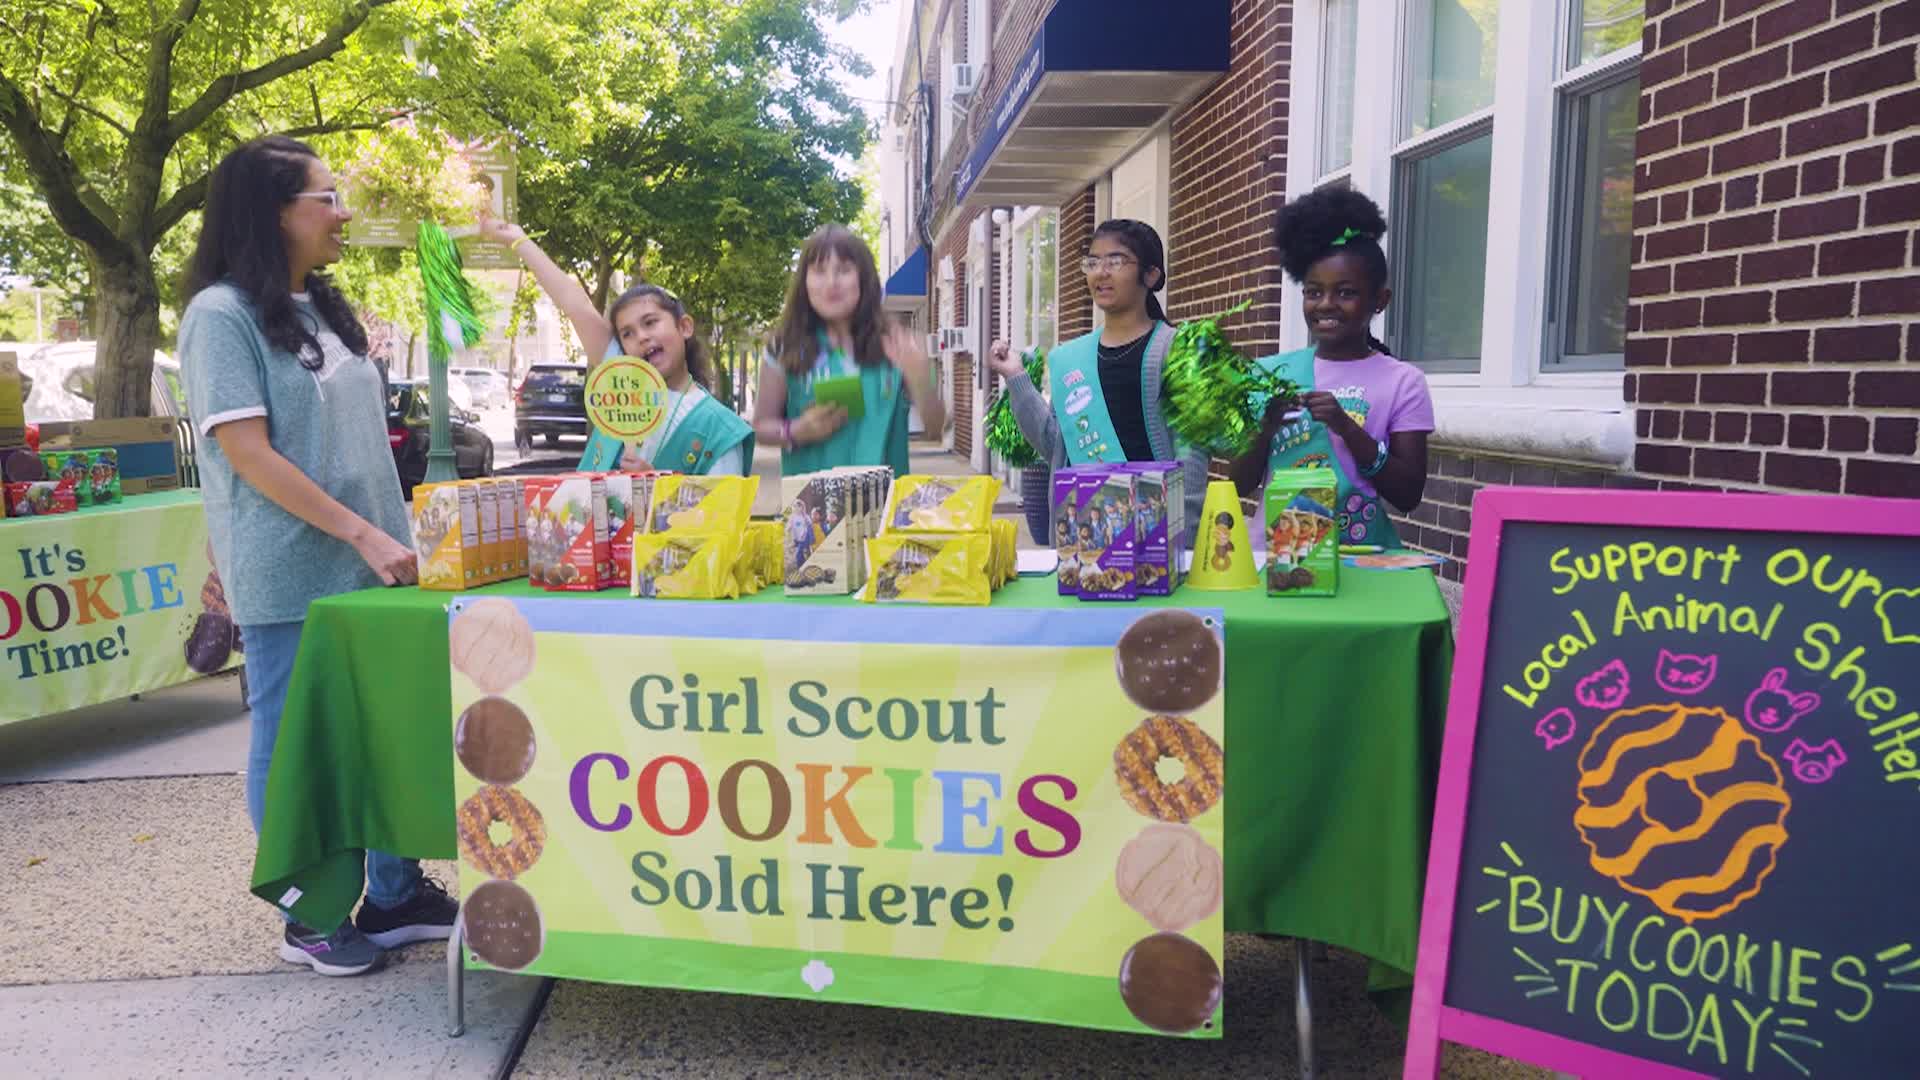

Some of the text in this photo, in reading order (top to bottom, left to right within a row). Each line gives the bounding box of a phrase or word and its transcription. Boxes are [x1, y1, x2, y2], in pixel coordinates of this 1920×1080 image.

[589, 391, 664, 408] COOKIE
[605, 408, 651, 422] Time!
[612, 375, 639, 389] It's
[18, 543, 87, 579] It's
[1766, 548, 1882, 608] Our
[7, 625, 130, 680] Time!
[1503, 609, 1597, 708] Local
[1613, 591, 1784, 641] Animal
[629, 673, 1006, 745] Girl Scout
[569, 752, 1082, 858] COOKIES
[631, 851, 1014, 932] Sold Here!
[1509, 875, 1873, 1022] BUY COOKIES
[1555, 959, 1774, 1073] TODAY
